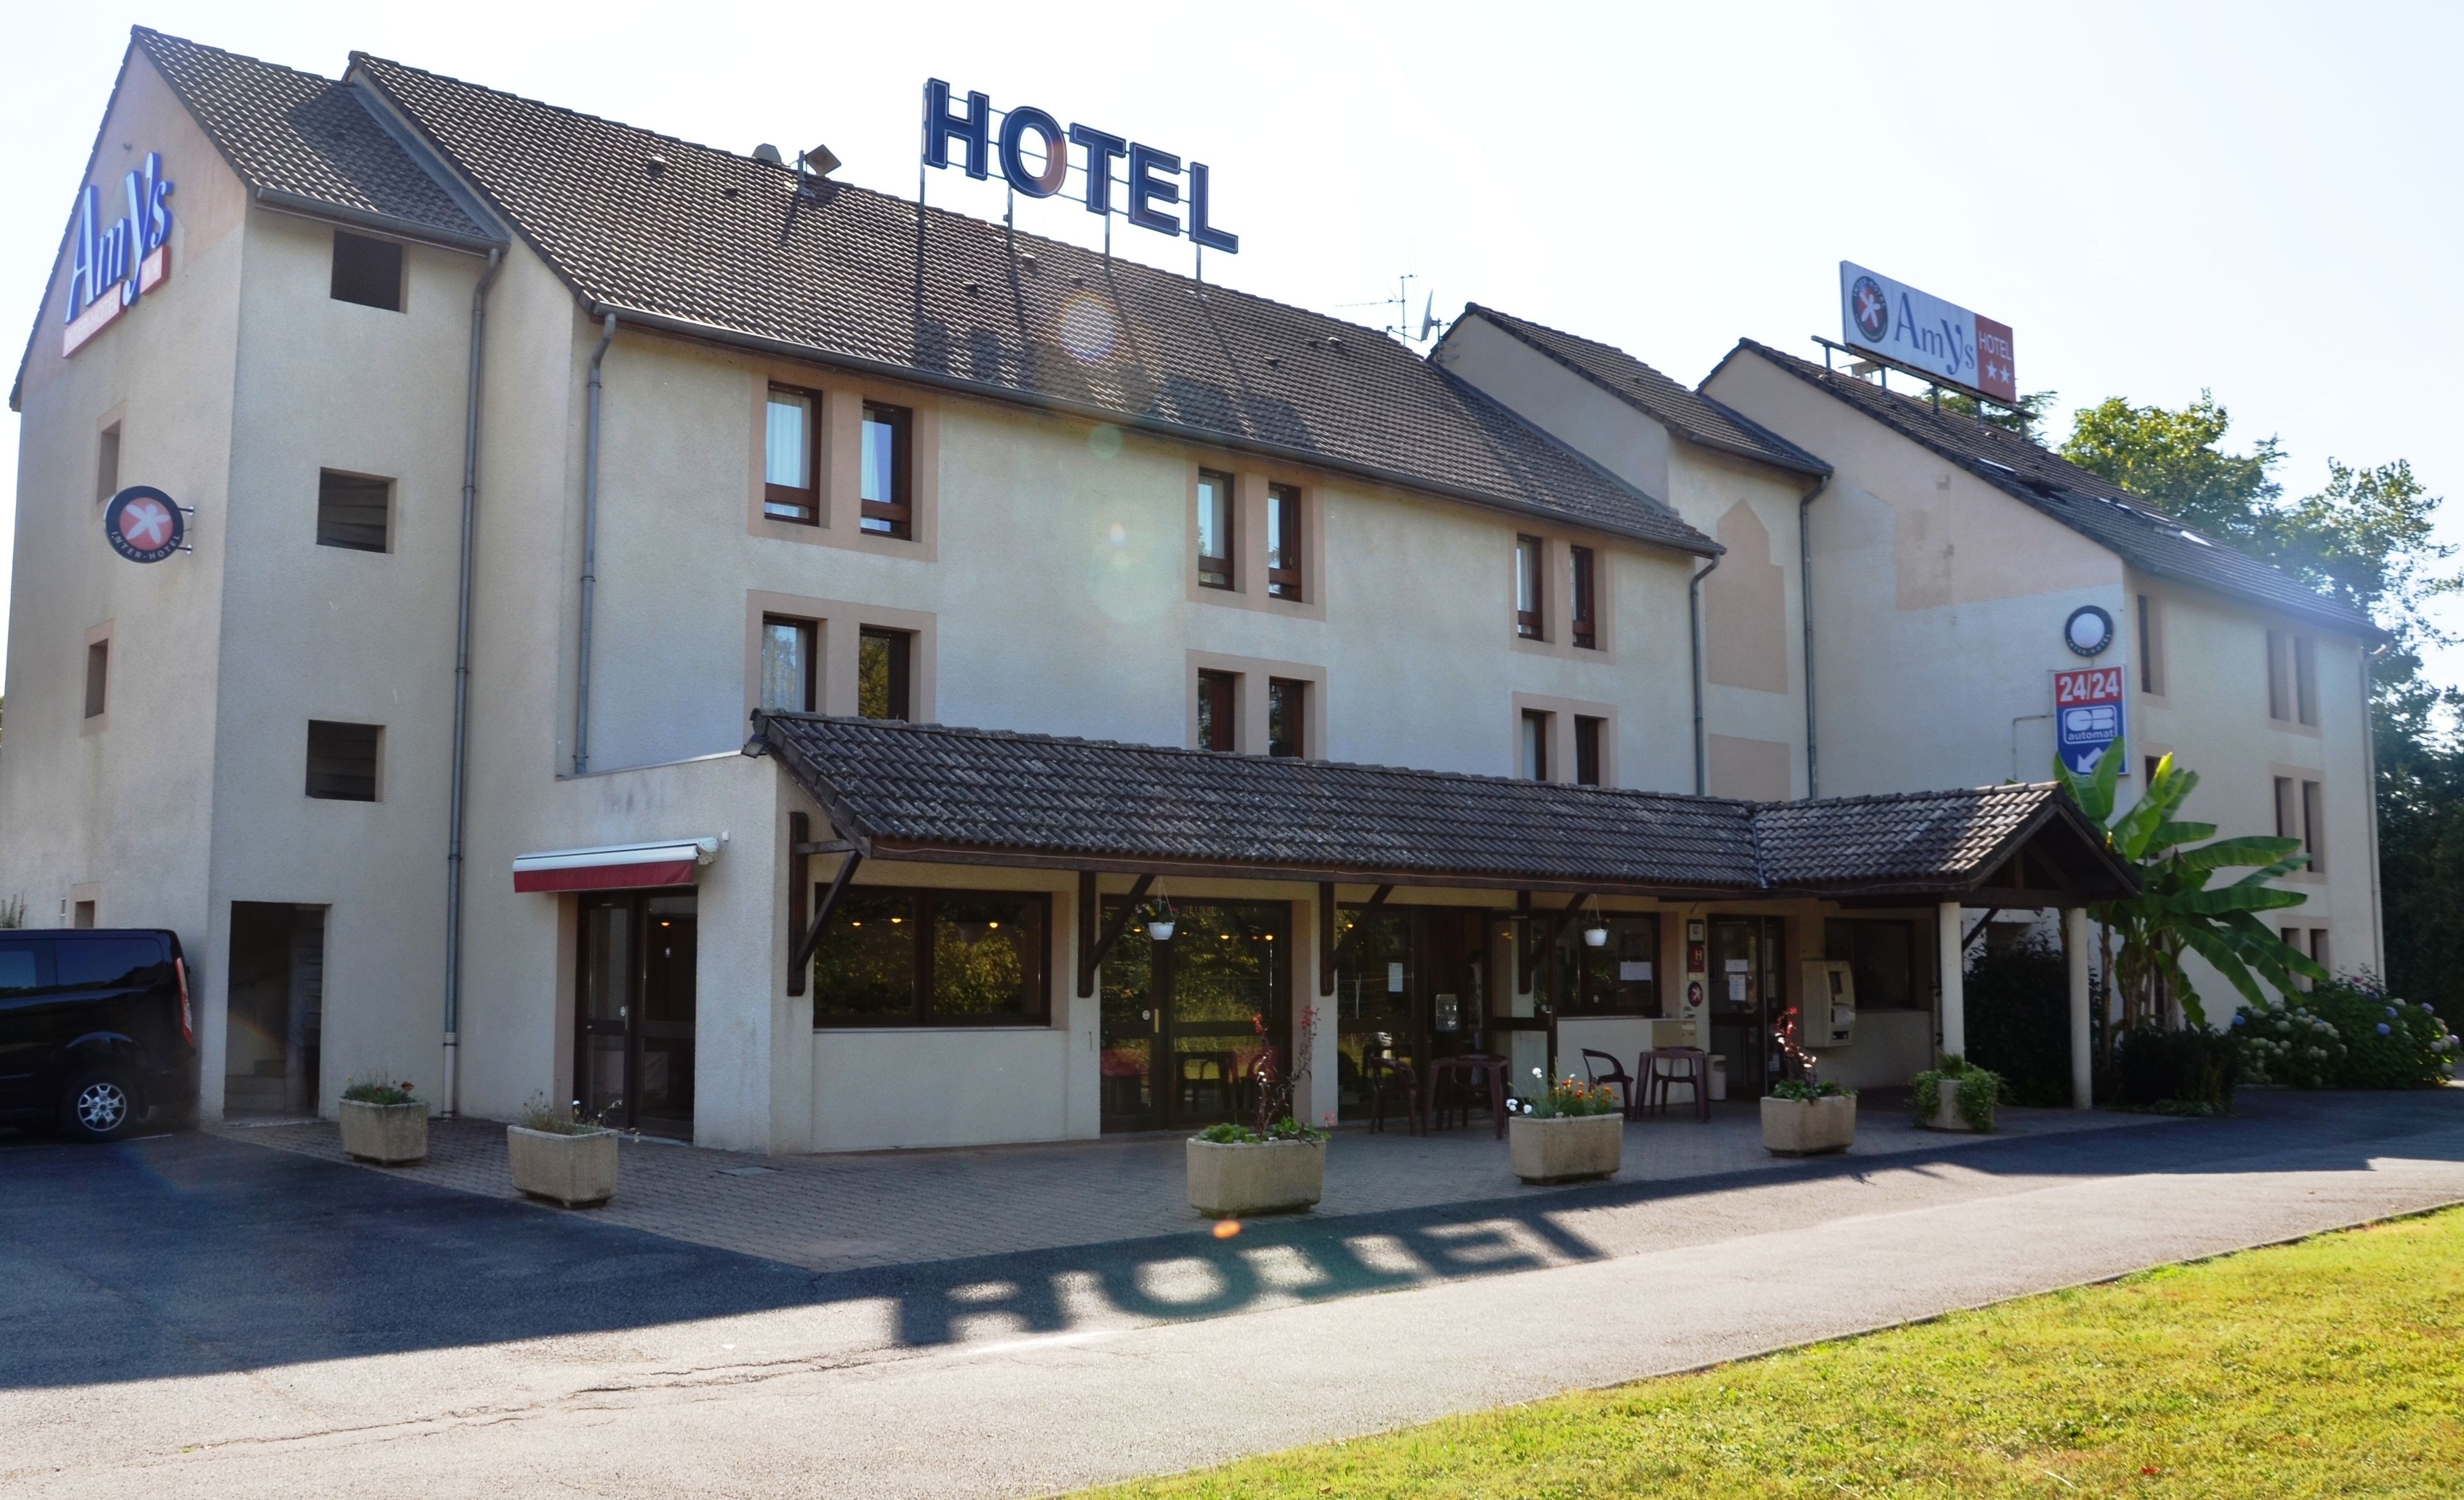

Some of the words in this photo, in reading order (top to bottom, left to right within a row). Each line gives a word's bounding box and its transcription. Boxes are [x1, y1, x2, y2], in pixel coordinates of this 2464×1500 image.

[924, 77, 1238, 254] HOTEL
[1978, 330, 2012, 361] HOTEL
[110, 530, 182, 560] INTER-HOTEL
[2059, 671, 2119, 702] 24/24
[2067, 728, 2115, 741] automat
